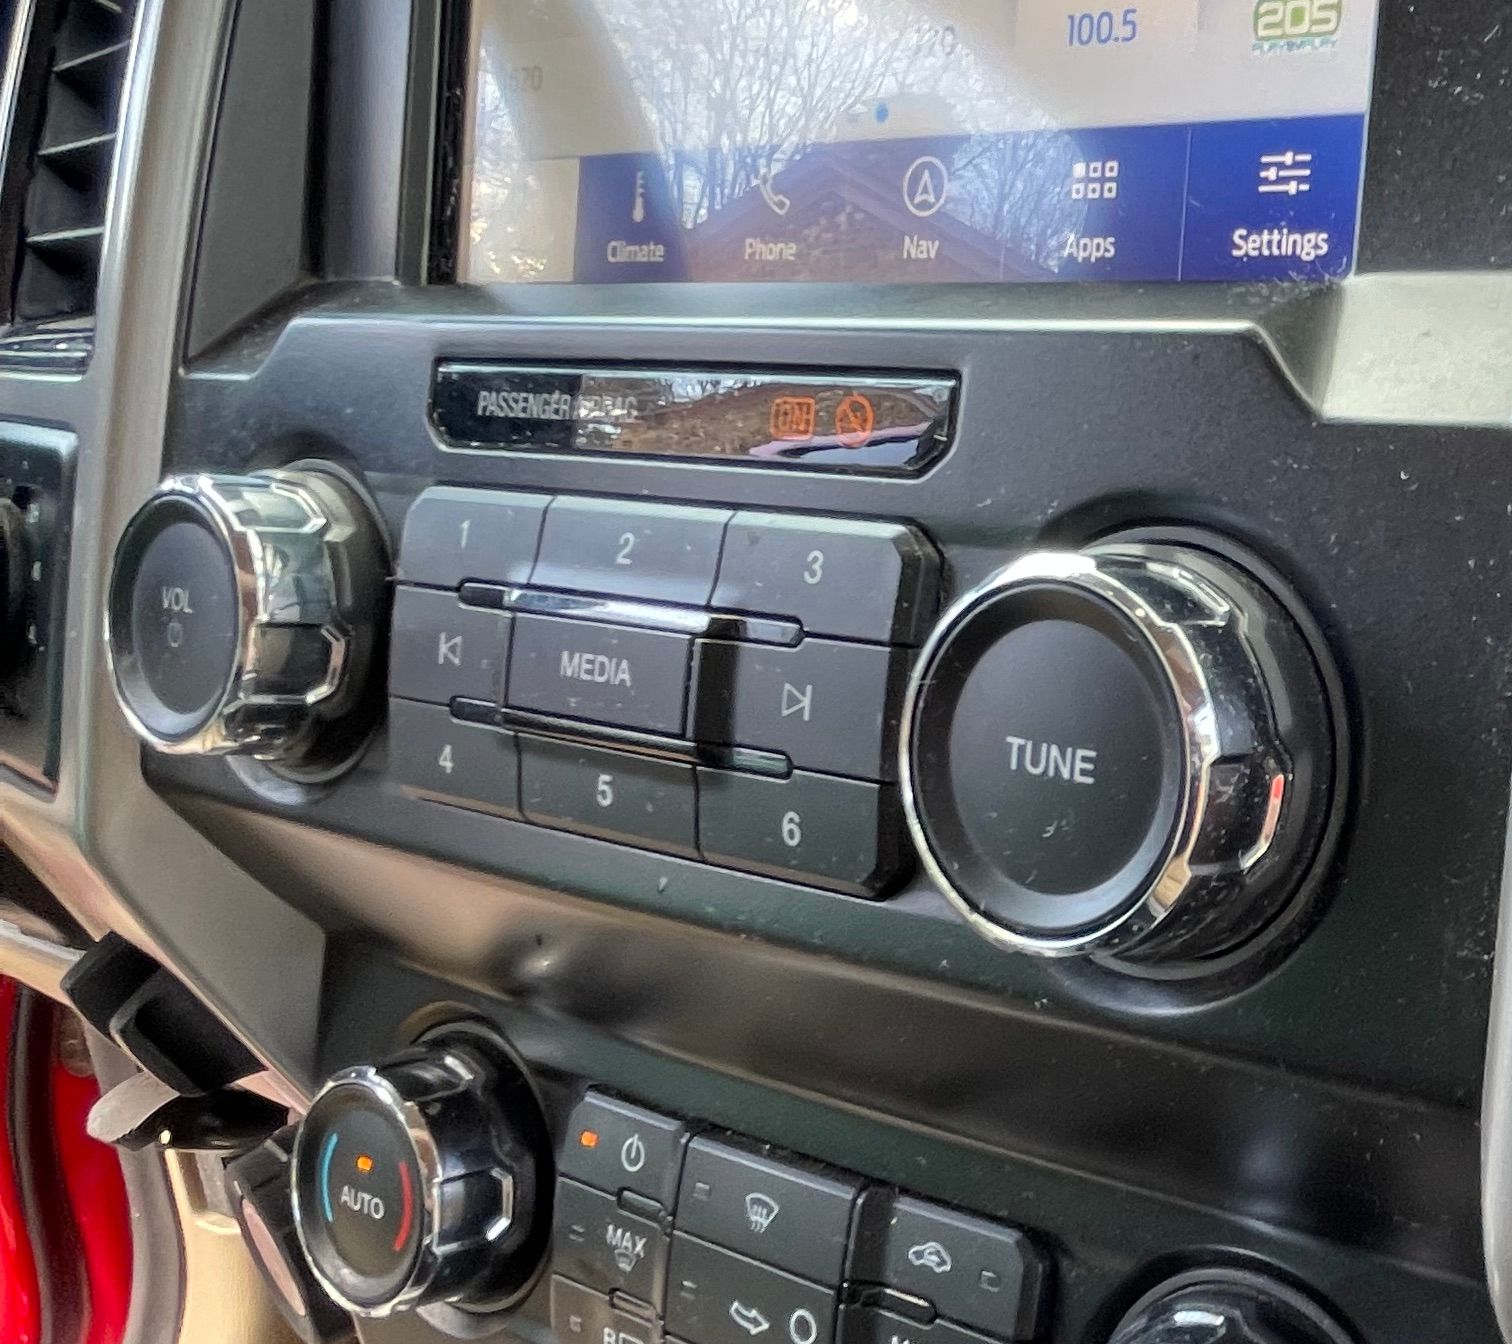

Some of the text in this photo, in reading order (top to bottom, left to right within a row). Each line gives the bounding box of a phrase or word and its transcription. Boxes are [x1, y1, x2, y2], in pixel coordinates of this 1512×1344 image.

[1067, 8, 1137, 47] 100.5
[607, 240, 665, 263] Climate
[744, 237, 797, 261] Phone
[903, 235, 939, 260] Nav
[1063, 233, 1116, 263] Apps
[1232, 229, 1329, 262] Settings
[477, 391, 571, 420] PASSENGER
[459, 519, 472, 549] 1
[615, 532, 635, 565] 2
[803, 550, 825, 585] 3
[161, 586, 194, 614] VOL
[560, 650, 632, 687] MEDIA
[438, 744, 454, 774] 4
[1005, 735, 1097, 785] TUNE
[596, 774, 614, 808] 5
[781, 811, 801, 847] 6
[341, 1185, 385, 1220] AUTO
[605, 1224, 648, 1259] MAX
